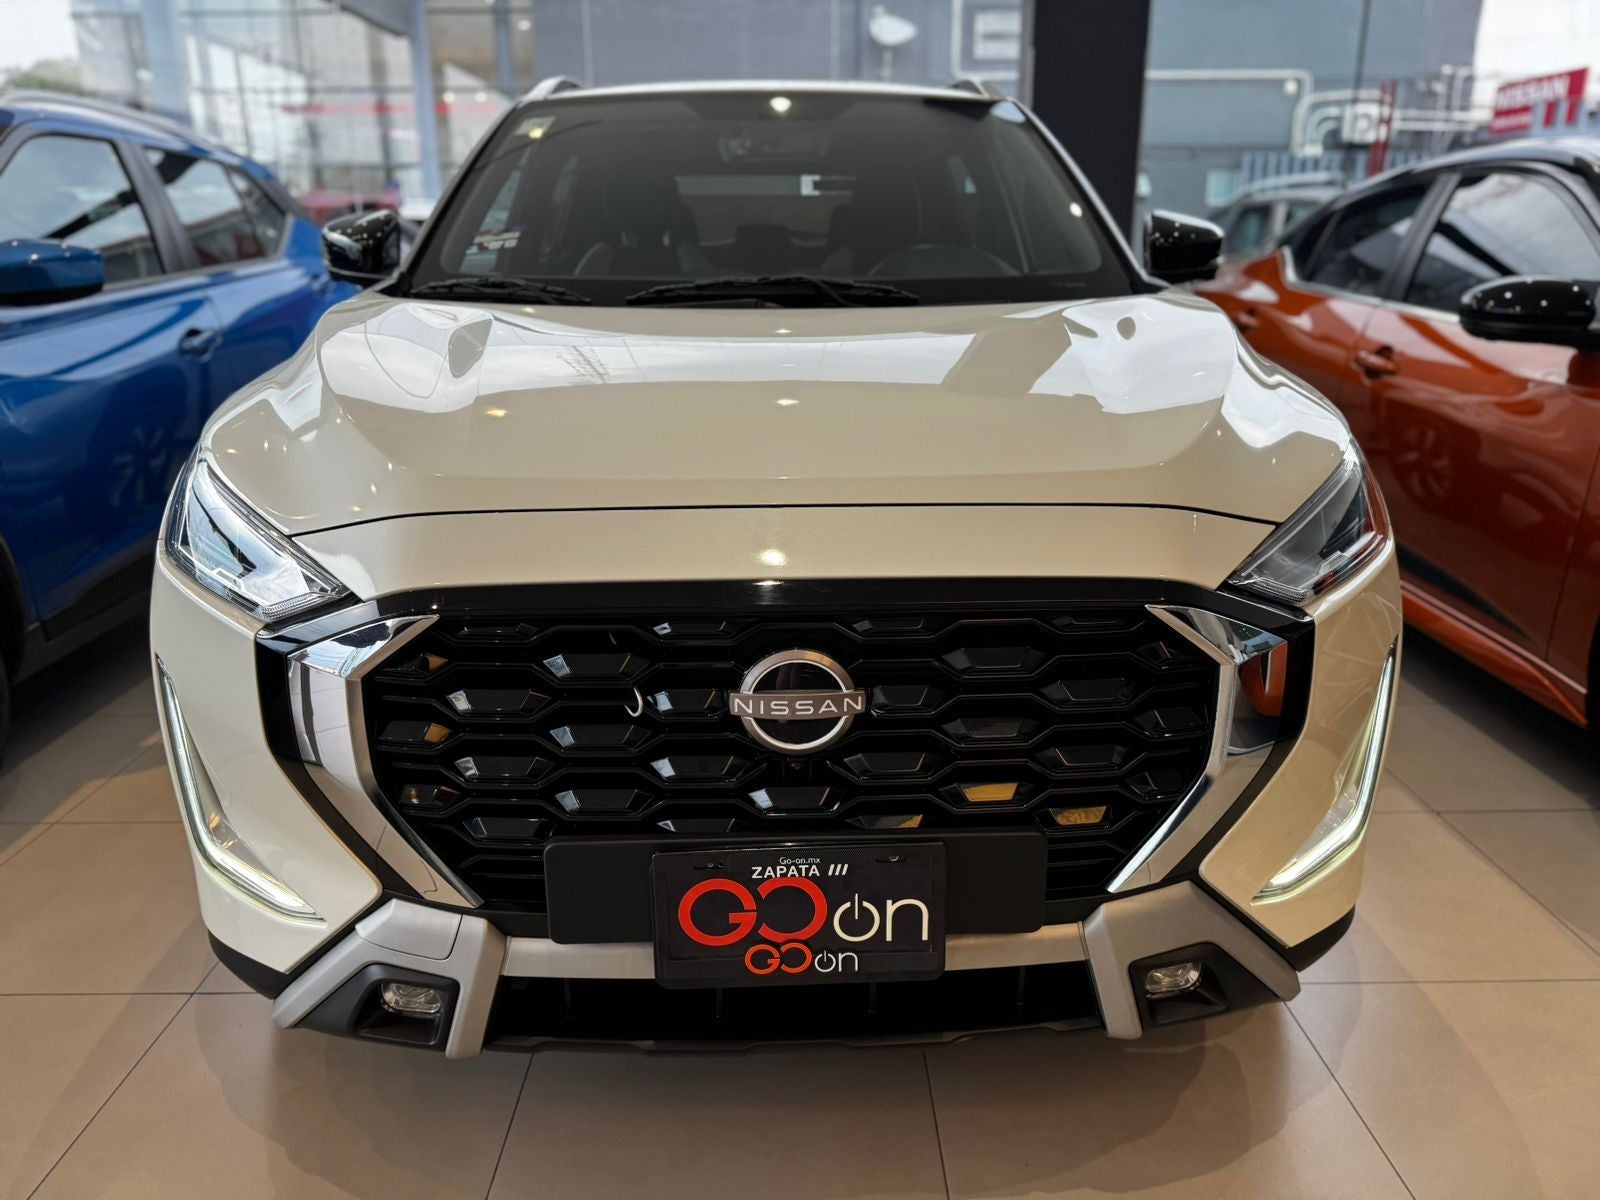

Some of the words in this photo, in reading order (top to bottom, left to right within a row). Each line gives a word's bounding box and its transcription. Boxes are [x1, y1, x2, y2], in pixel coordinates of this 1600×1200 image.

[733, 696, 862, 715] NISSAN
[779, 856, 821, 865] Go-on.mx
[751, 864, 821, 879] ZAPATA
